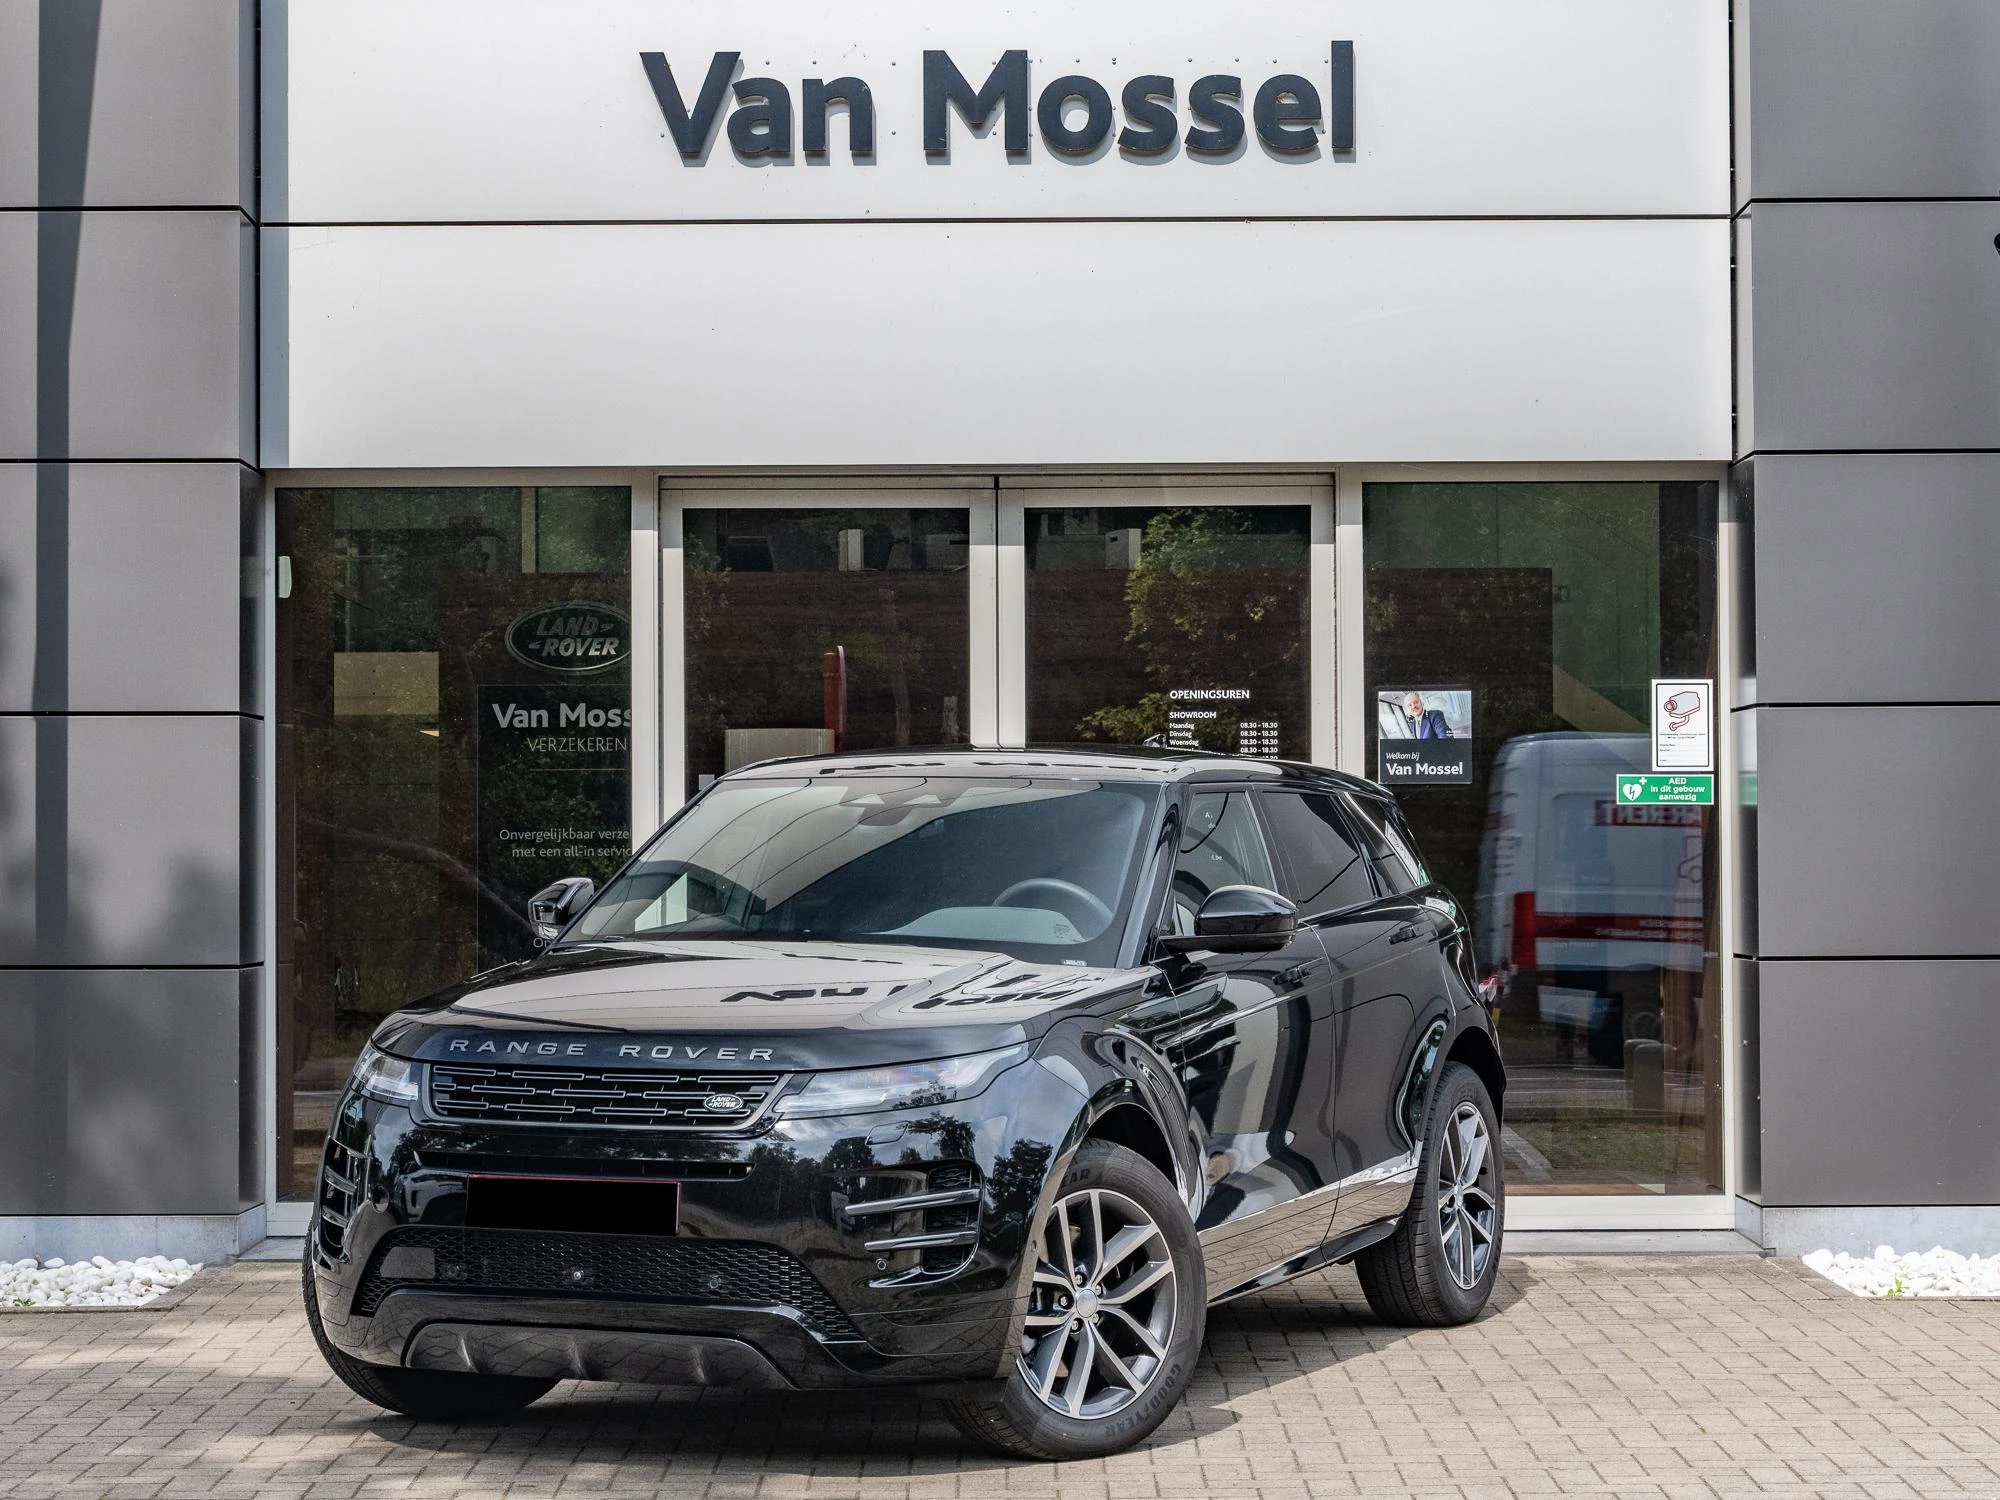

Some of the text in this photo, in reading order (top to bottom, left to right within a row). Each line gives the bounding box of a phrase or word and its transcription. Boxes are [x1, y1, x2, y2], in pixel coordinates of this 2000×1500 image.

[639, 40, 1354, 155] Van Mossel
[535, 616, 600, 636] LAND
[541, 637, 620, 657] ROVER
[1169, 689, 1250, 700] OPENINGSUREN
[491, 703, 549, 729] Van
[1169, 711, 1217, 719] SHOWROOM
[1169, 722, 1195, 730] Maandag
[1169, 730, 1192, 738] Dinsdag
[527, 737, 627, 752] VERZEKEREN
[1169, 739, 1199, 747] Woensdag
[1386, 752, 1420, 761] Welkom bij
[1386, 762, 1463, 776] Van Mossel
[1668, 777, 1687, 785] AED
[1673, 785, 1706, 794] gebouw
[1658, 793, 1697, 802] aanwezig
[499, 828, 631, 843] Onvergelijkbaar verze
[512, 847, 536, 857] met
[539, 849, 561, 857] een
[564, 845, 594, 857] all-in
[449, 1039, 775, 1061] RANGE ROVER
[1103, 1363, 1182, 1437] GOODYEAR
